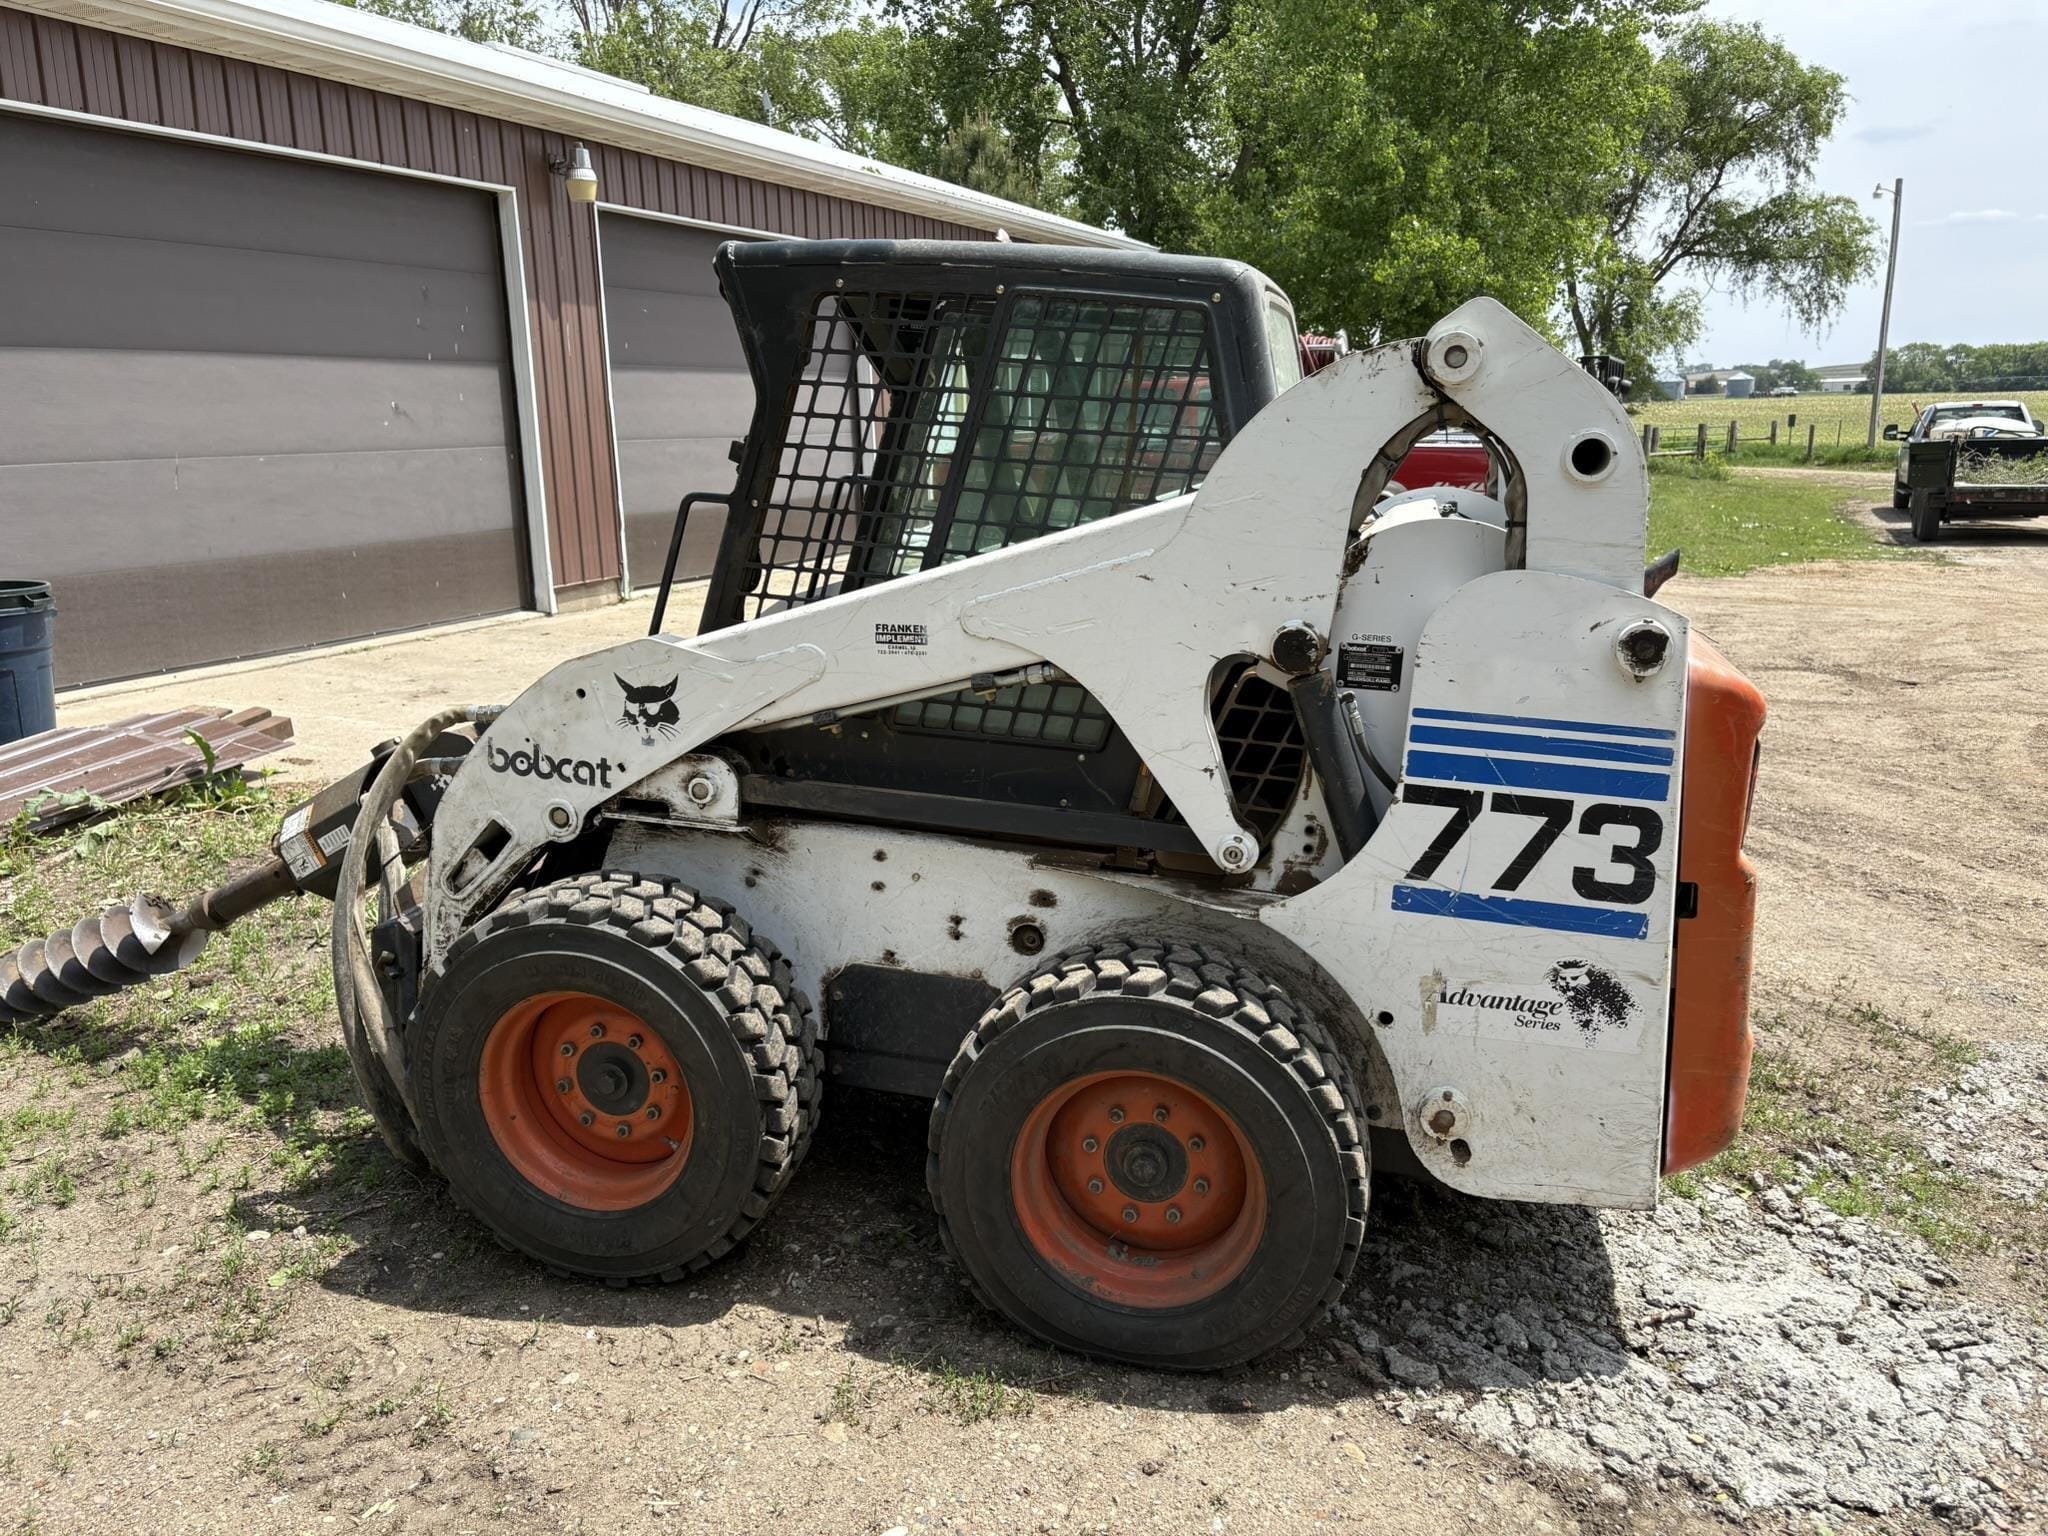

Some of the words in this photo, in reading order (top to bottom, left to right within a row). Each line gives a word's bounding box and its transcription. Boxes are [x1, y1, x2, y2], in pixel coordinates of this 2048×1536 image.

[875, 624, 927, 632] FRANKEN
[876, 634, 928, 644] IMPLEMENT
[1351, 633, 1392, 643] G-SERIES
[487, 737, 612, 789] bobcat
[1402, 783, 1663, 905] 773
[1428, 980, 1563, 1020] Advantage
[1513, 1014, 1561, 1032] Series
